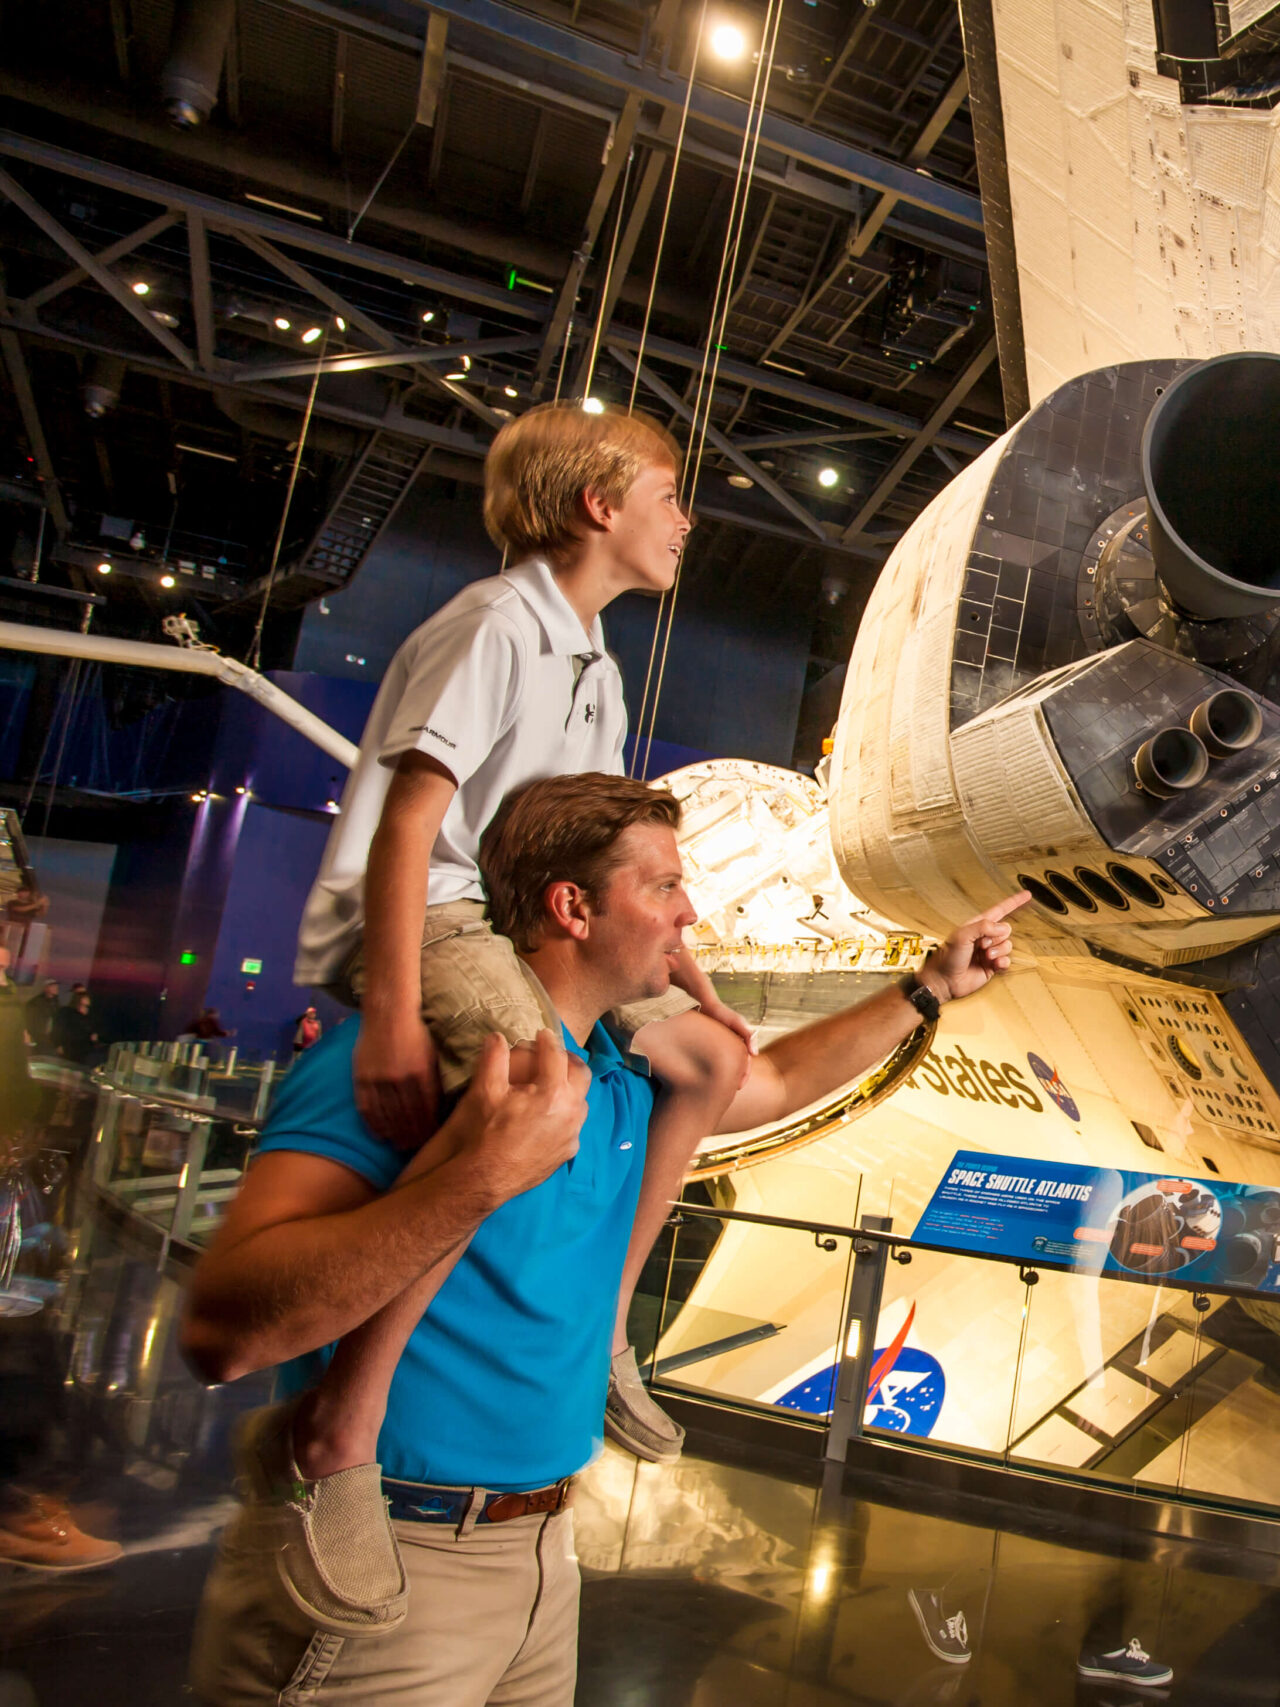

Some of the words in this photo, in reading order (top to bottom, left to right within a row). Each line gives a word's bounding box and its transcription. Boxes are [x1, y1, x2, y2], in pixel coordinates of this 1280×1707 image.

[947, 1168, 988, 1188] SPACE
[985, 1174, 1037, 1195] SHUTTLE
[1034, 1180, 1093, 1202] ATLANTIS
